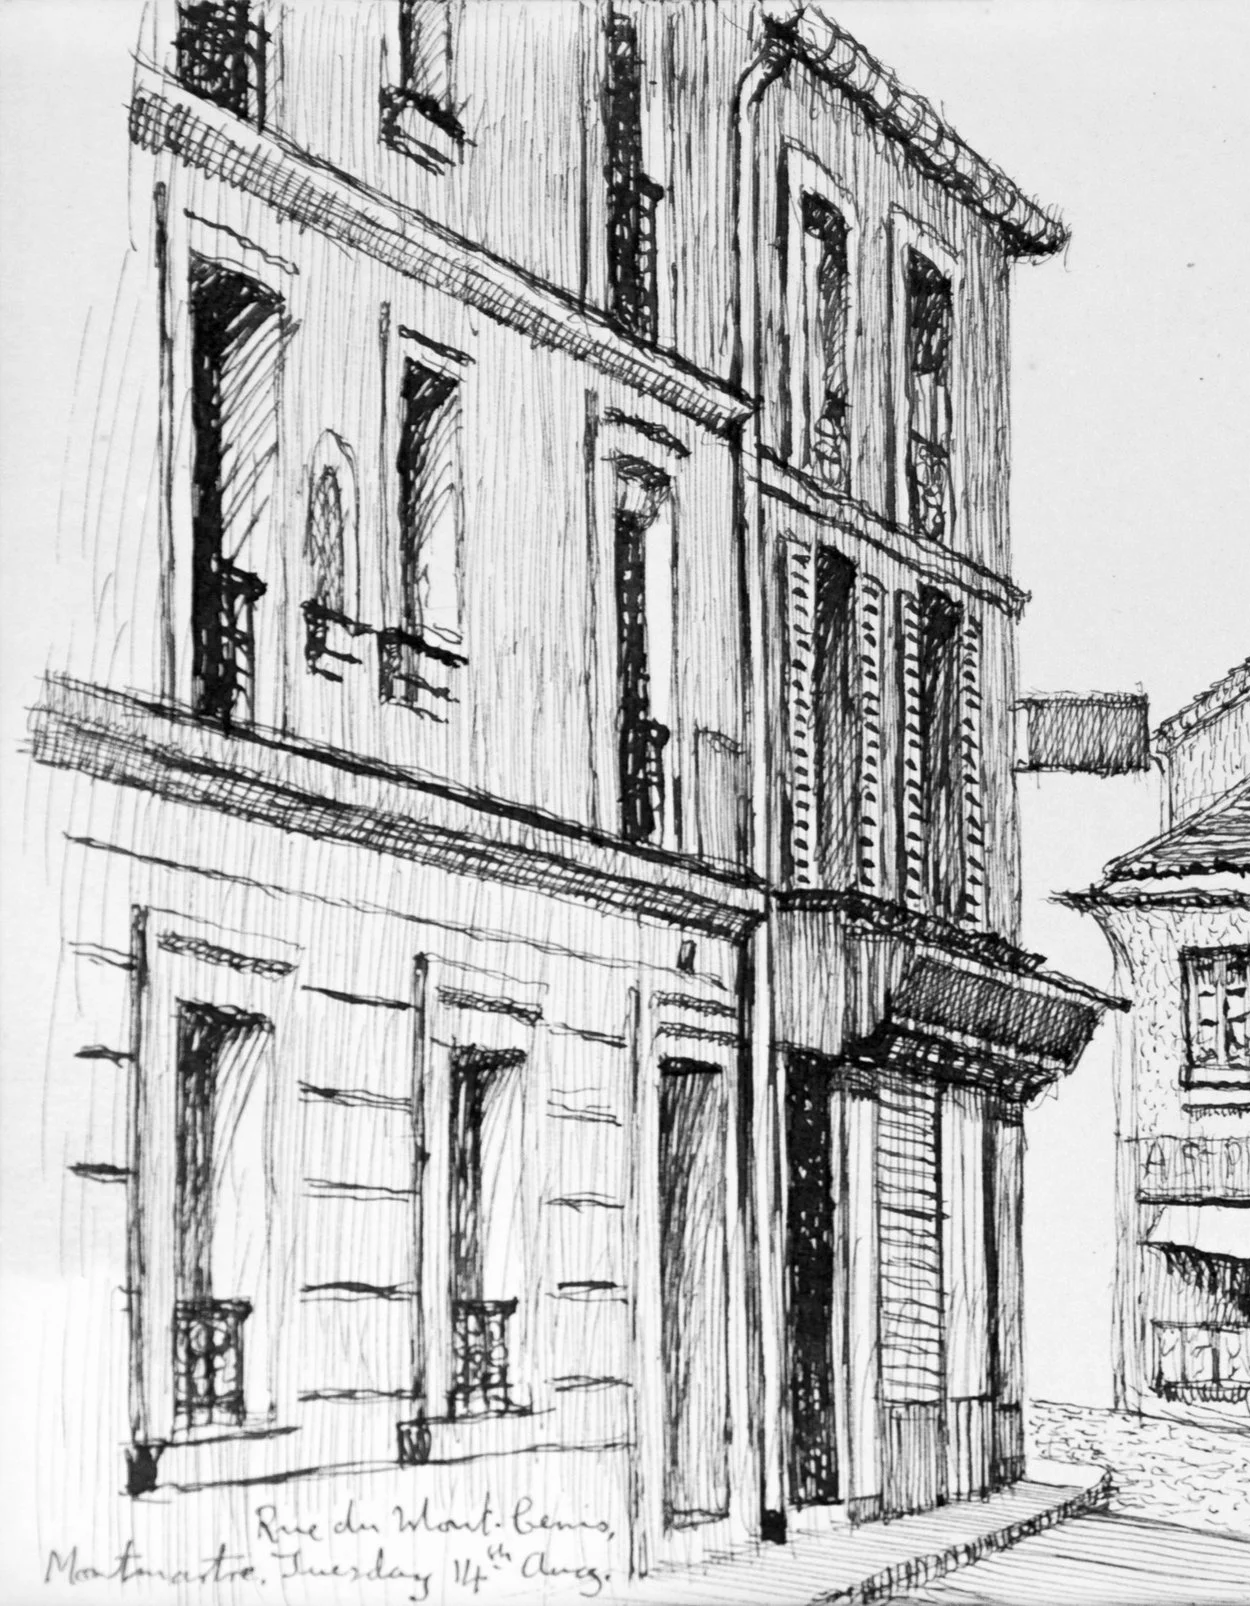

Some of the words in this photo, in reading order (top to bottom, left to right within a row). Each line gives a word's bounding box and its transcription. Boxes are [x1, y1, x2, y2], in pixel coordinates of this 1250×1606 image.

[255, 1504, 324, 1544] Rue
[334, 1499, 380, 1534] du
[271, 1547, 432, 1601] Tuesday
[521, 1551, 612, 1598] Aug.
